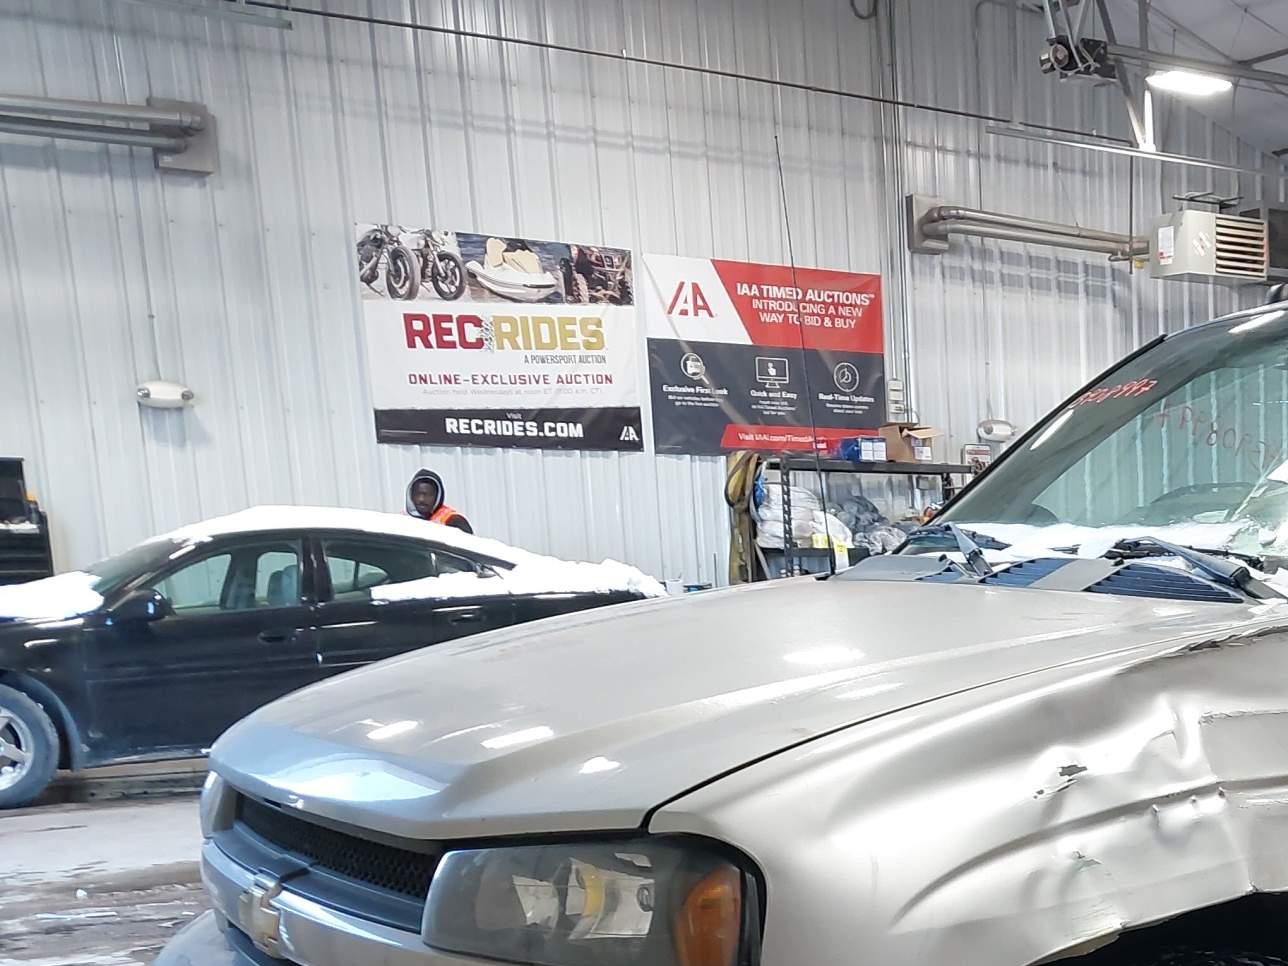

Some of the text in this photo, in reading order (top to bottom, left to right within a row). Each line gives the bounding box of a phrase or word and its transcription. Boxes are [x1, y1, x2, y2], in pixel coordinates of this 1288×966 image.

[736, 282, 760, 297] IAA
[760, 285, 803, 300] TIMED
[752, 298, 862, 317] INTRODUCING A NEW
[759, 311, 856, 329] WAY TO BID & BUY
[524, 354, 607, 365] A POWERSPORT AUCTION
[408, 373, 613, 385] ONLINE-EXCLUSIVE AUCTION
[445, 417, 584, 438] RECRIDES.COM
